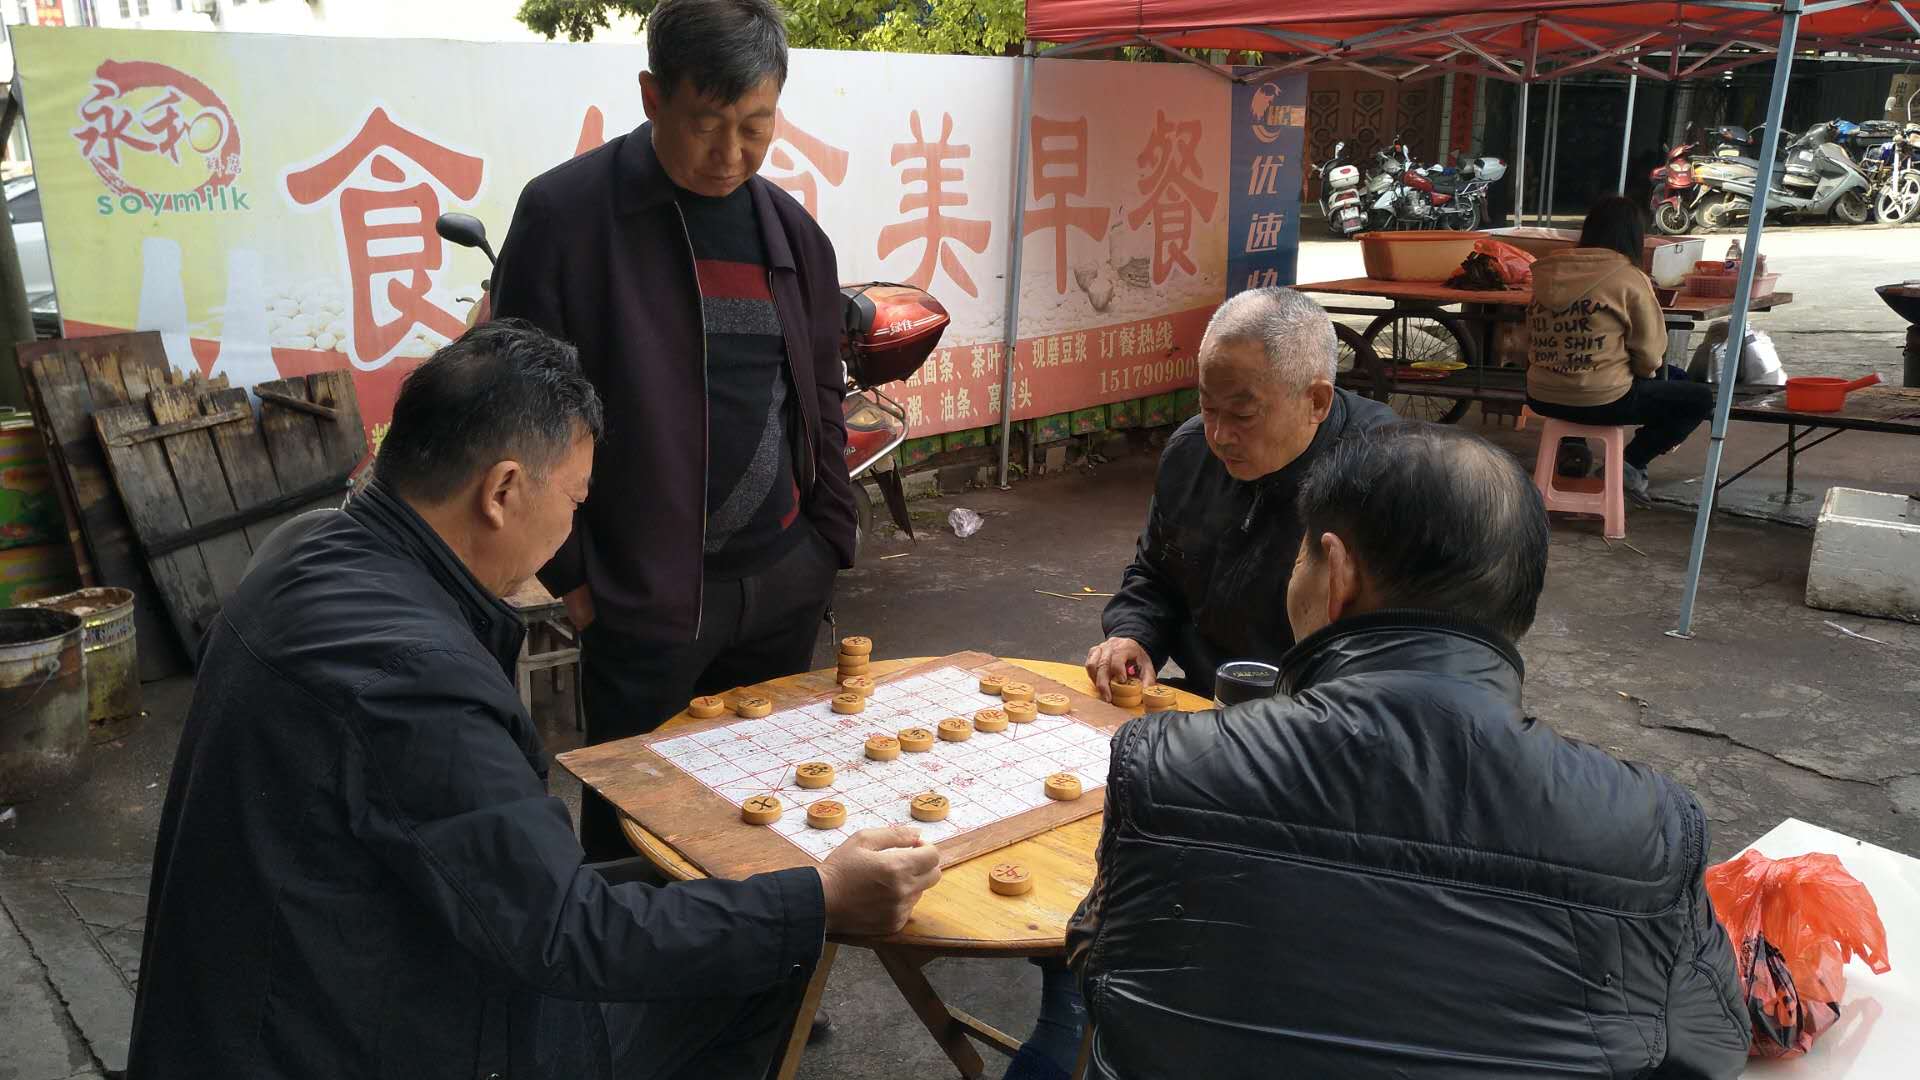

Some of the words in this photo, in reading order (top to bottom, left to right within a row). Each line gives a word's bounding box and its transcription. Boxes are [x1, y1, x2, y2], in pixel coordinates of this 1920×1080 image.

[97, 186, 250, 217] soymilk
[1553, 319, 1592, 333] OUR
[1099, 322, 1174, 360] 订餐热线
[1564, 335, 1607, 350] SHIT
[1566, 353, 1593, 364] THE
[1099, 357, 1198, 394] 151790900
